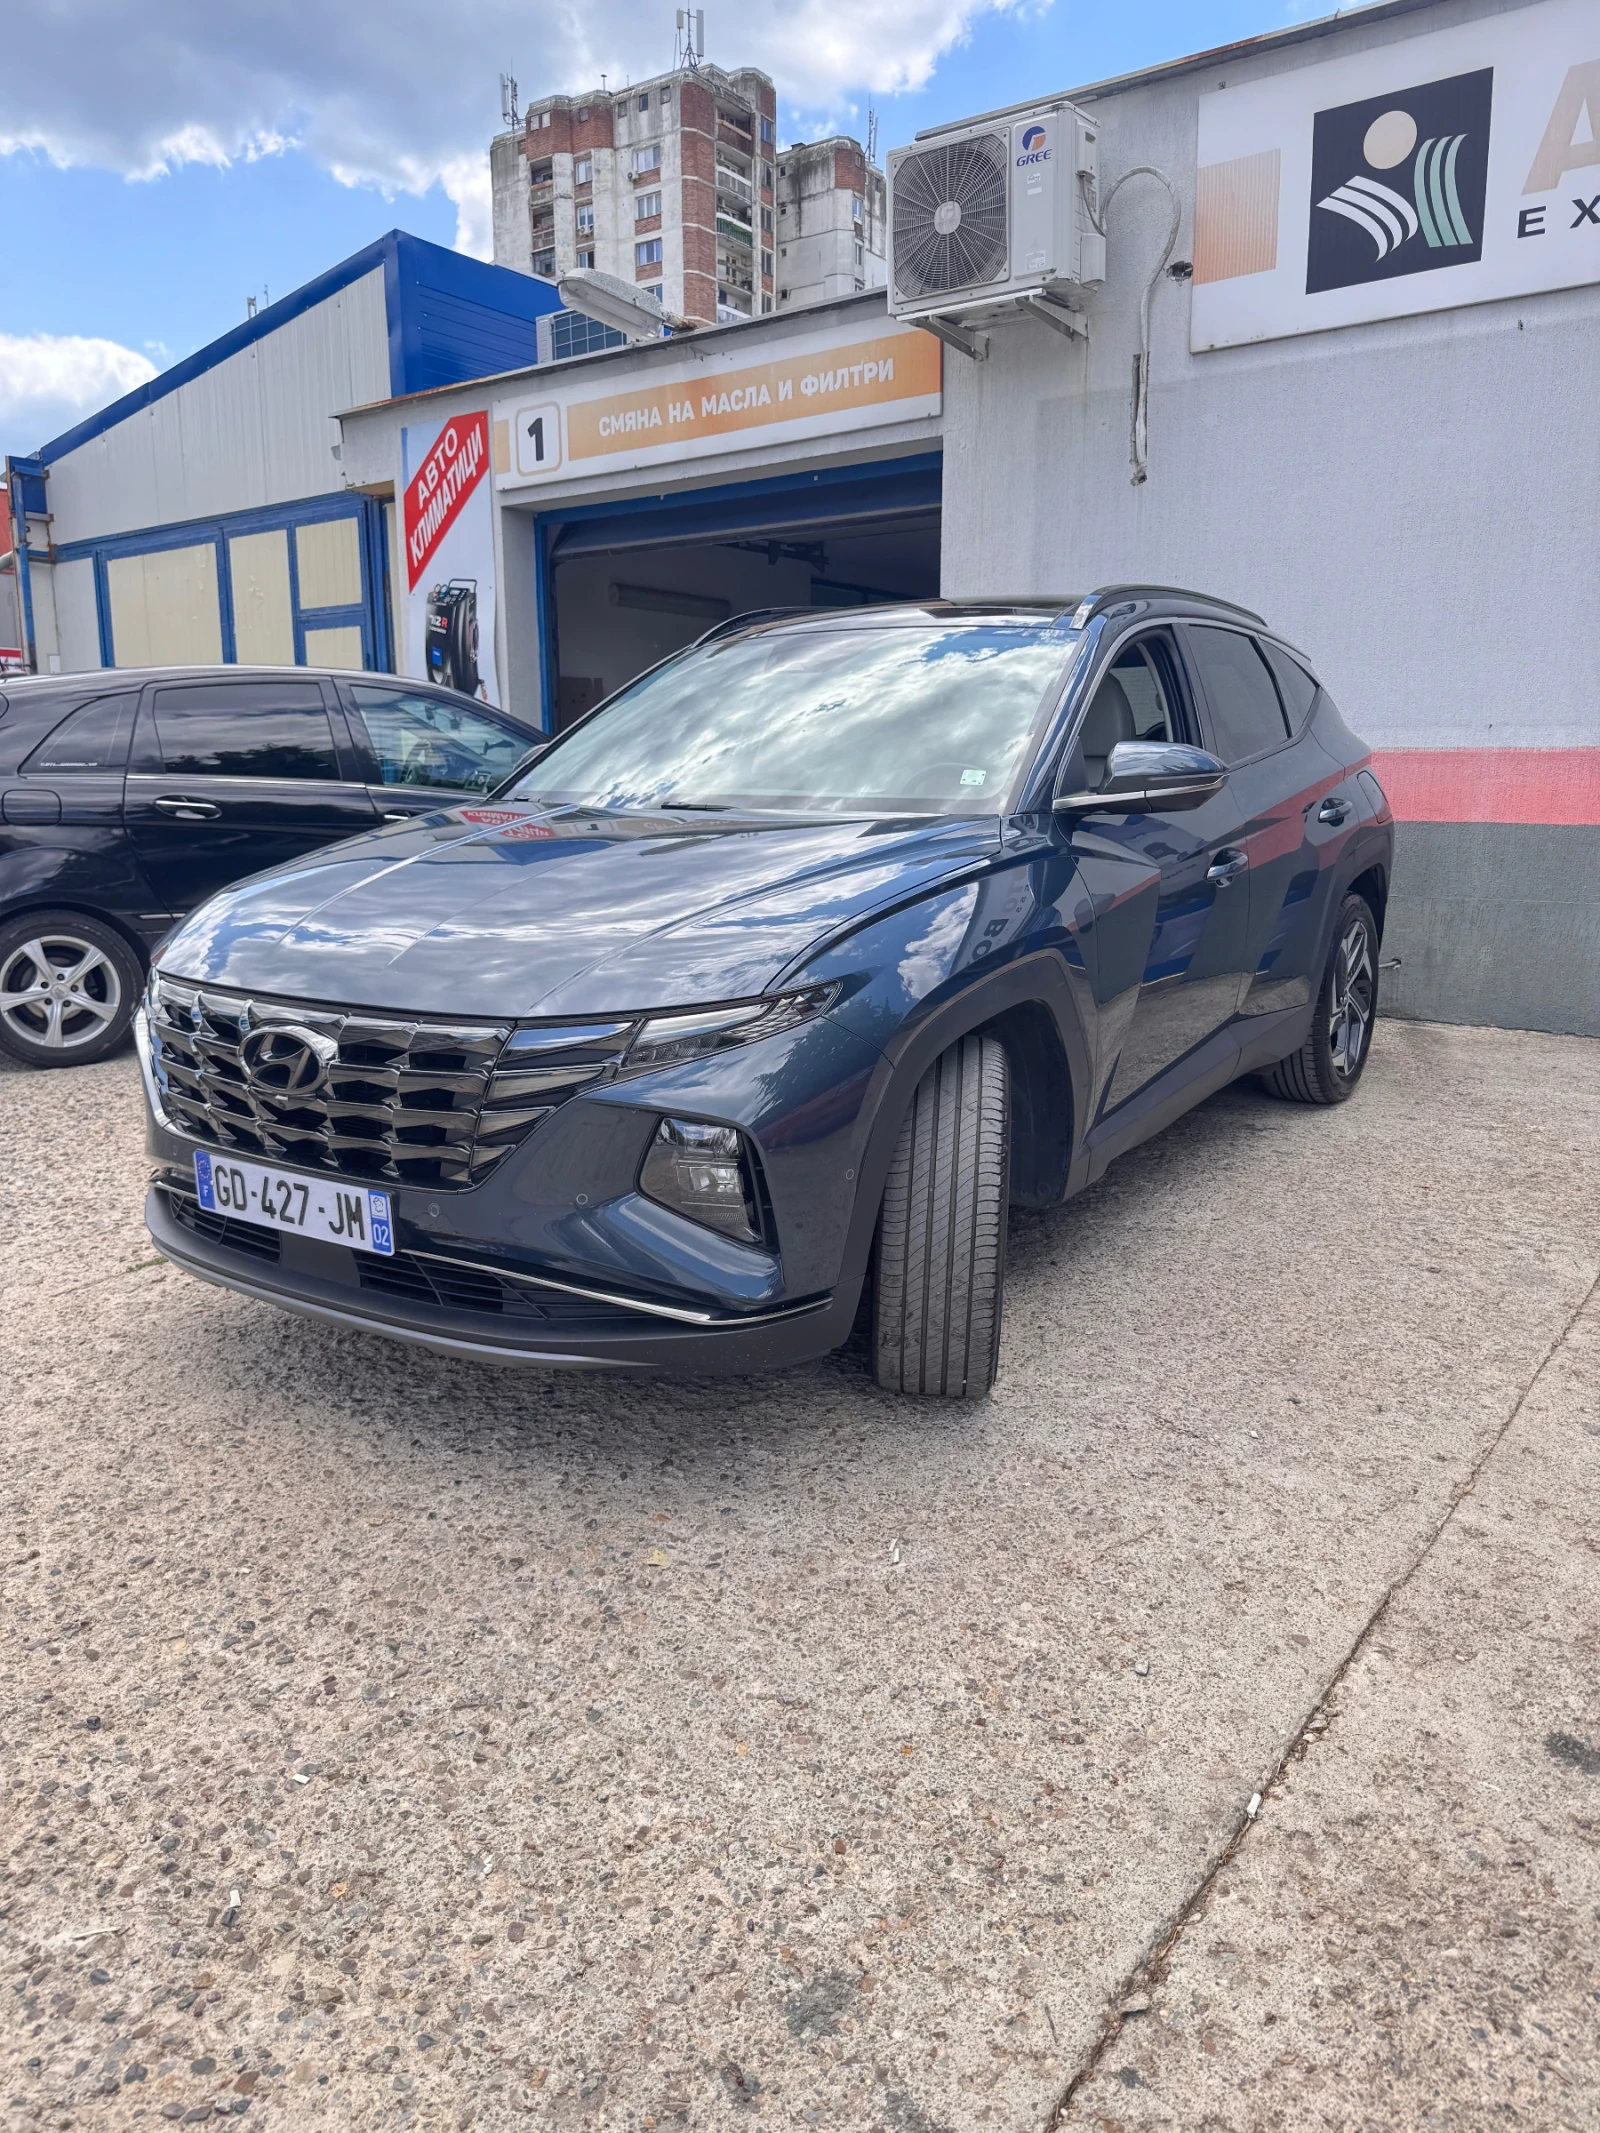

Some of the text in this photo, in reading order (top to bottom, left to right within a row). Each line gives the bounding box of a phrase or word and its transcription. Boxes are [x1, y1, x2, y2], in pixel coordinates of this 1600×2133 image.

[1016, 149, 1052, 167] GREE
[527, 357, 894, 461] 1 СМЯНА НА МАСЛА И ФИЛТРИ
[409, 422, 484, 568] КЛИМАТИЦИ
[416, 427, 459, 510] АВТО
[203, 1185, 209, 1197] F
[373, 1223, 390, 1246] 02
